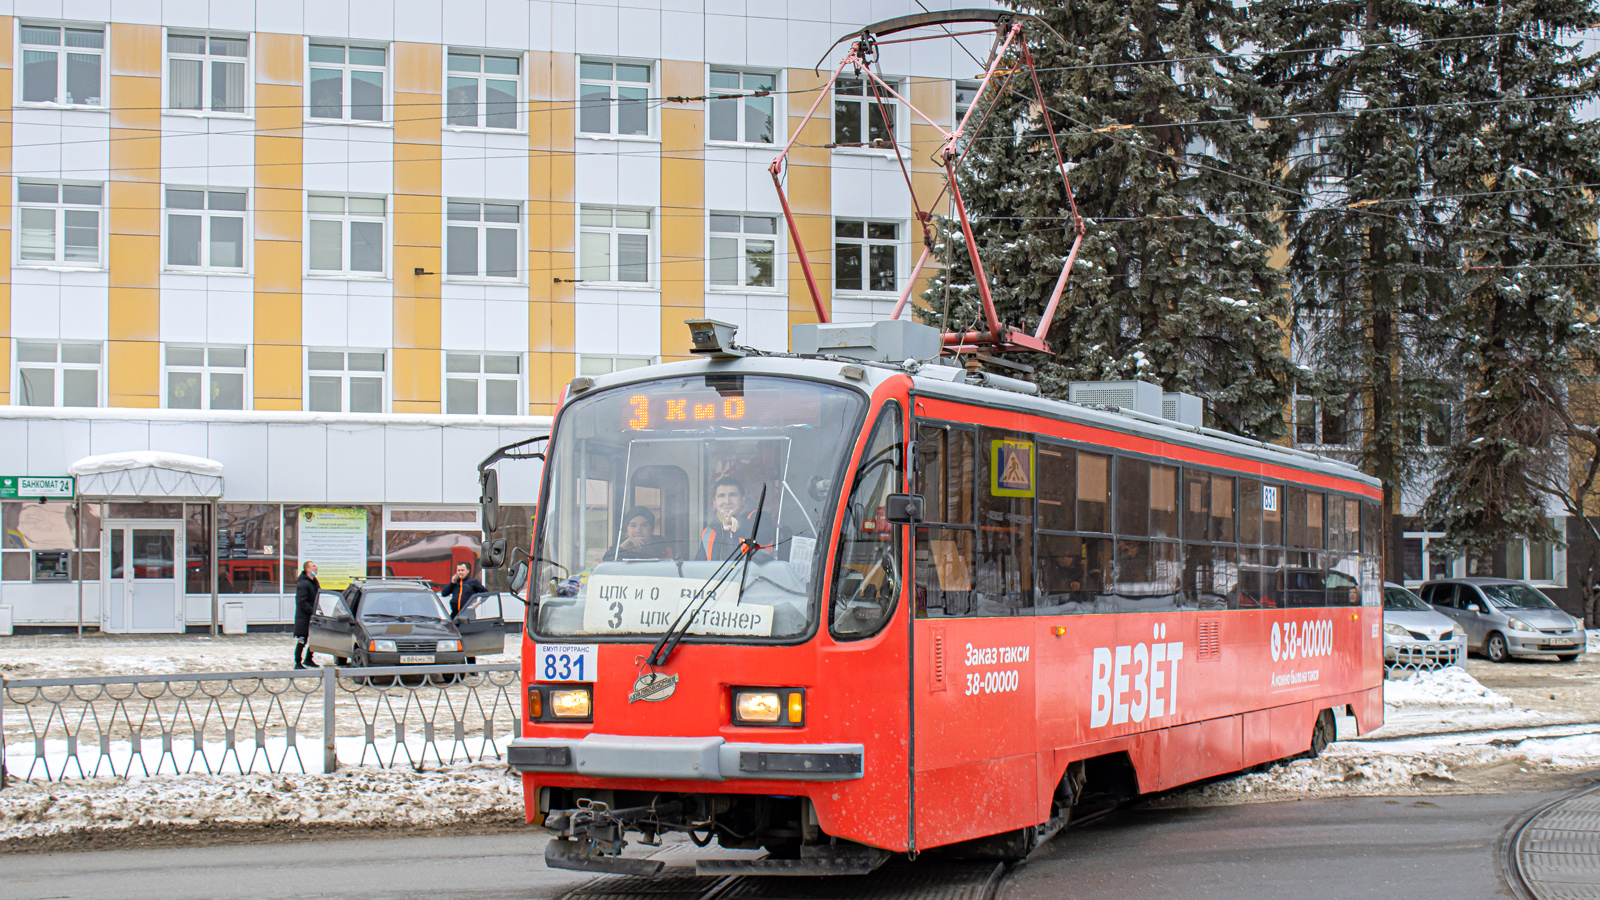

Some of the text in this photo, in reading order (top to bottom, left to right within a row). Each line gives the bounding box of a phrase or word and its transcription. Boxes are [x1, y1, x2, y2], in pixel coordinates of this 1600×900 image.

[629, 394, 649, 429] 3
[22, 480, 69, 491] БАНКОМАТ 24
[1265, 487, 1275, 509] 831
[600, 585, 628, 601] ЦПК
[635, 588, 643, 600] и
[650, 587, 660, 601] О
[608, 601, 624, 629] 3
[640, 611, 671, 627] ЦПК
[1282, 619, 1333, 661] 38-00000
[545, 654, 584, 681] 831
[965, 642, 1030, 666] Заказ такси
[965, 669, 1019, 696] 38-00000
[1090, 622, 1184, 728] ВЕЗЁТ
